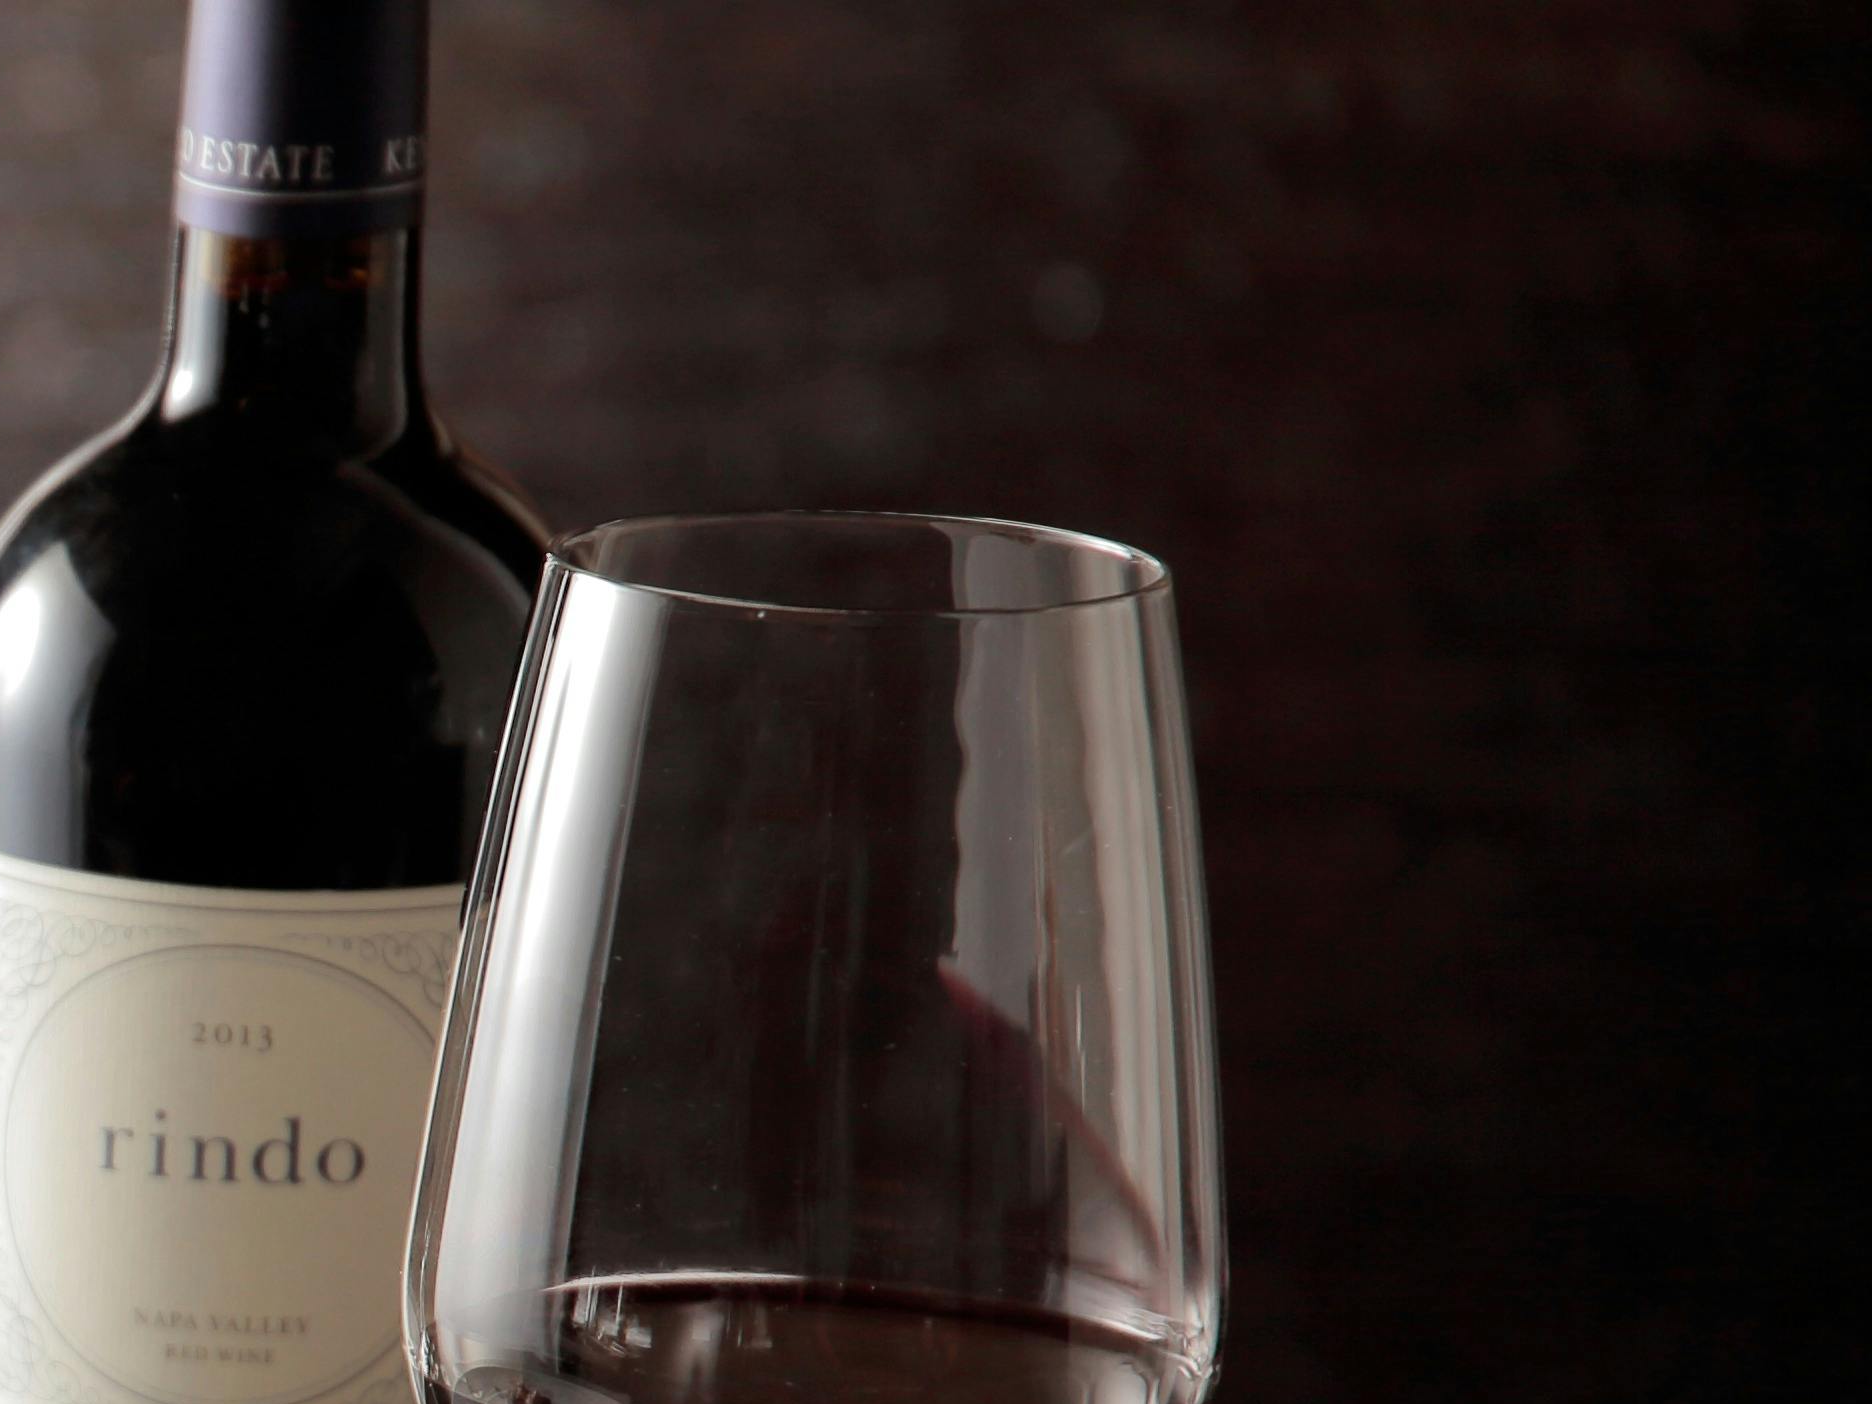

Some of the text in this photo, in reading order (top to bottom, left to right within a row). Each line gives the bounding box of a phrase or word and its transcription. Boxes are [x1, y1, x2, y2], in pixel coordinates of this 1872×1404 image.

[200, 135, 335, 180] ESTATE
[191, 1021, 275, 1051] 2013
[99, 1109, 366, 1186] rindo
[132, 1307, 313, 1336] NAPA VALLEY
[163, 1342, 277, 1366] RED WINE
